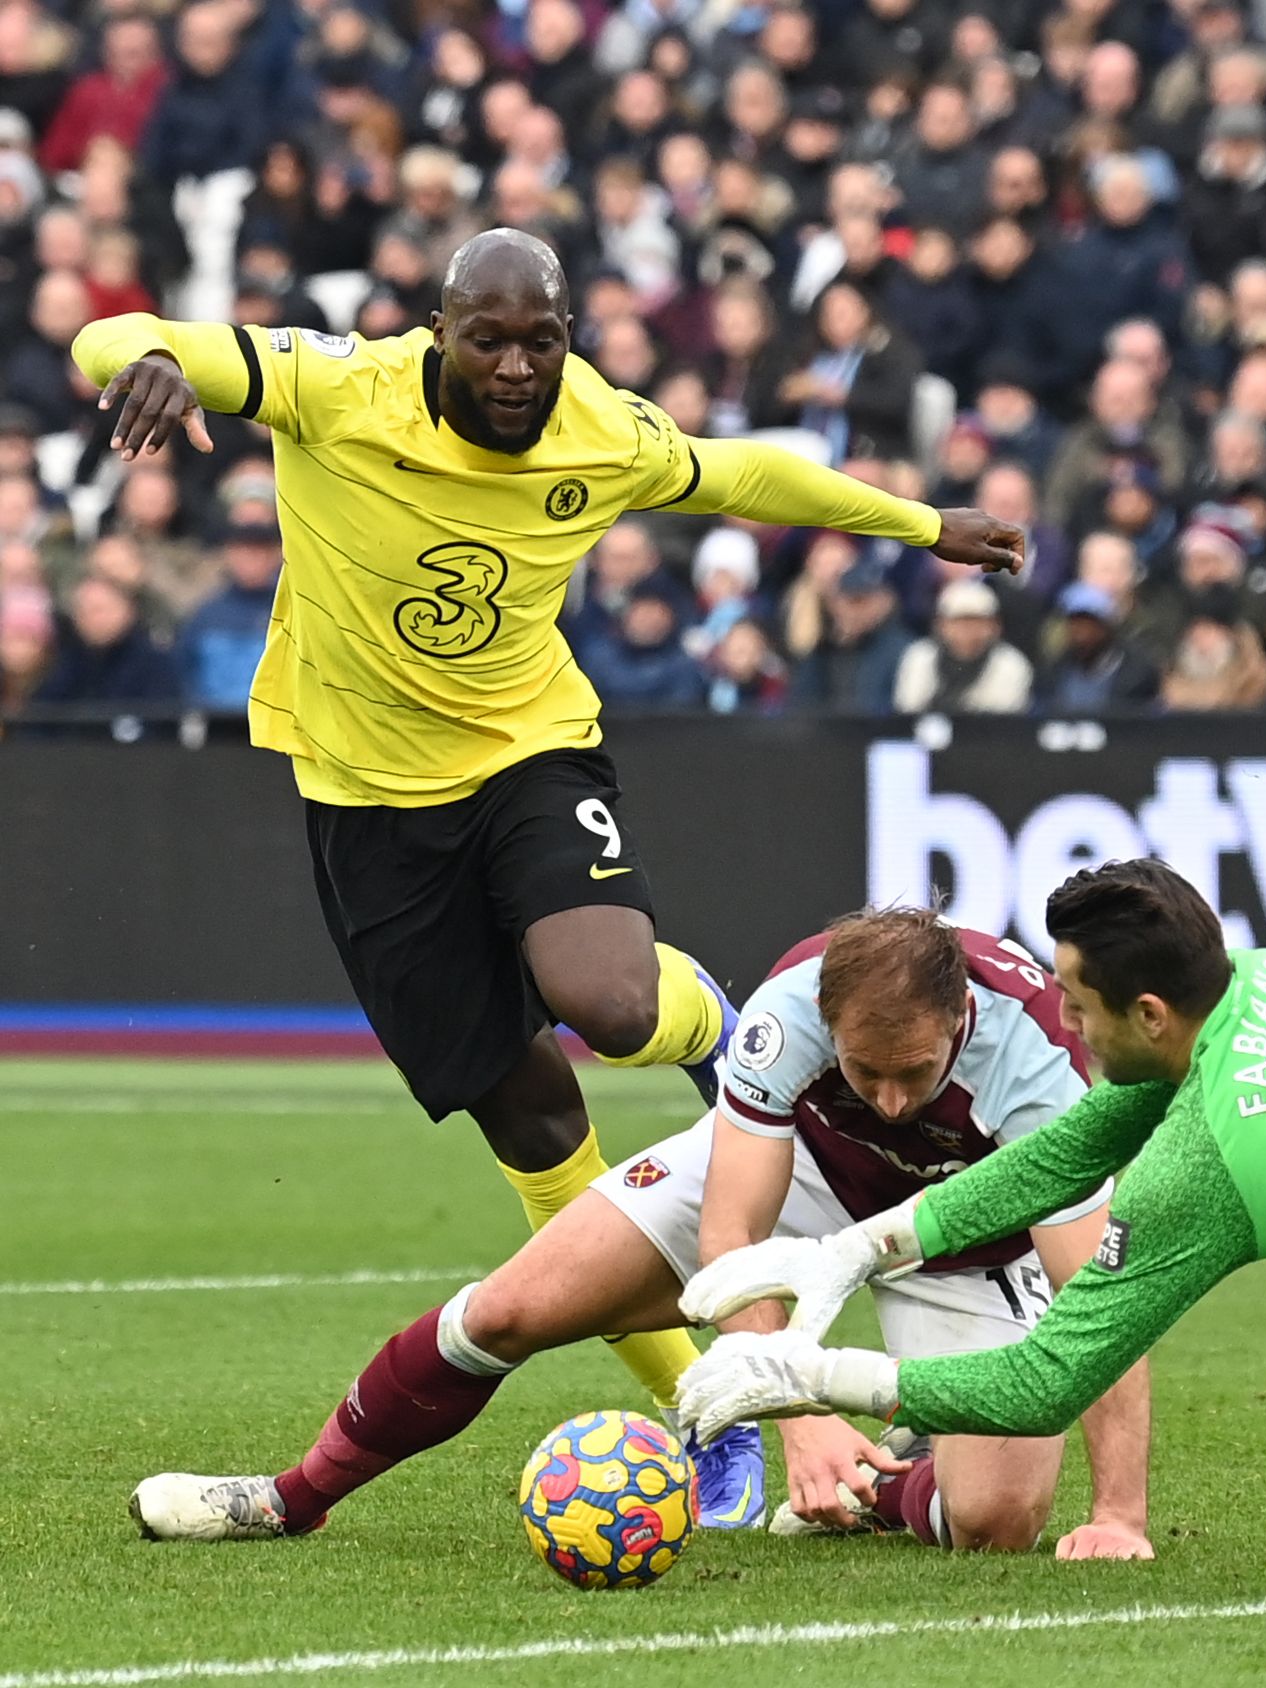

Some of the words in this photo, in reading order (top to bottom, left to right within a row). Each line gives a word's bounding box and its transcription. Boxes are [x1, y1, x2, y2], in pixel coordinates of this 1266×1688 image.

[393, 541, 508, 659] 3
[575, 798, 622, 859] 9
[985, 1266, 1050, 1320] 15
